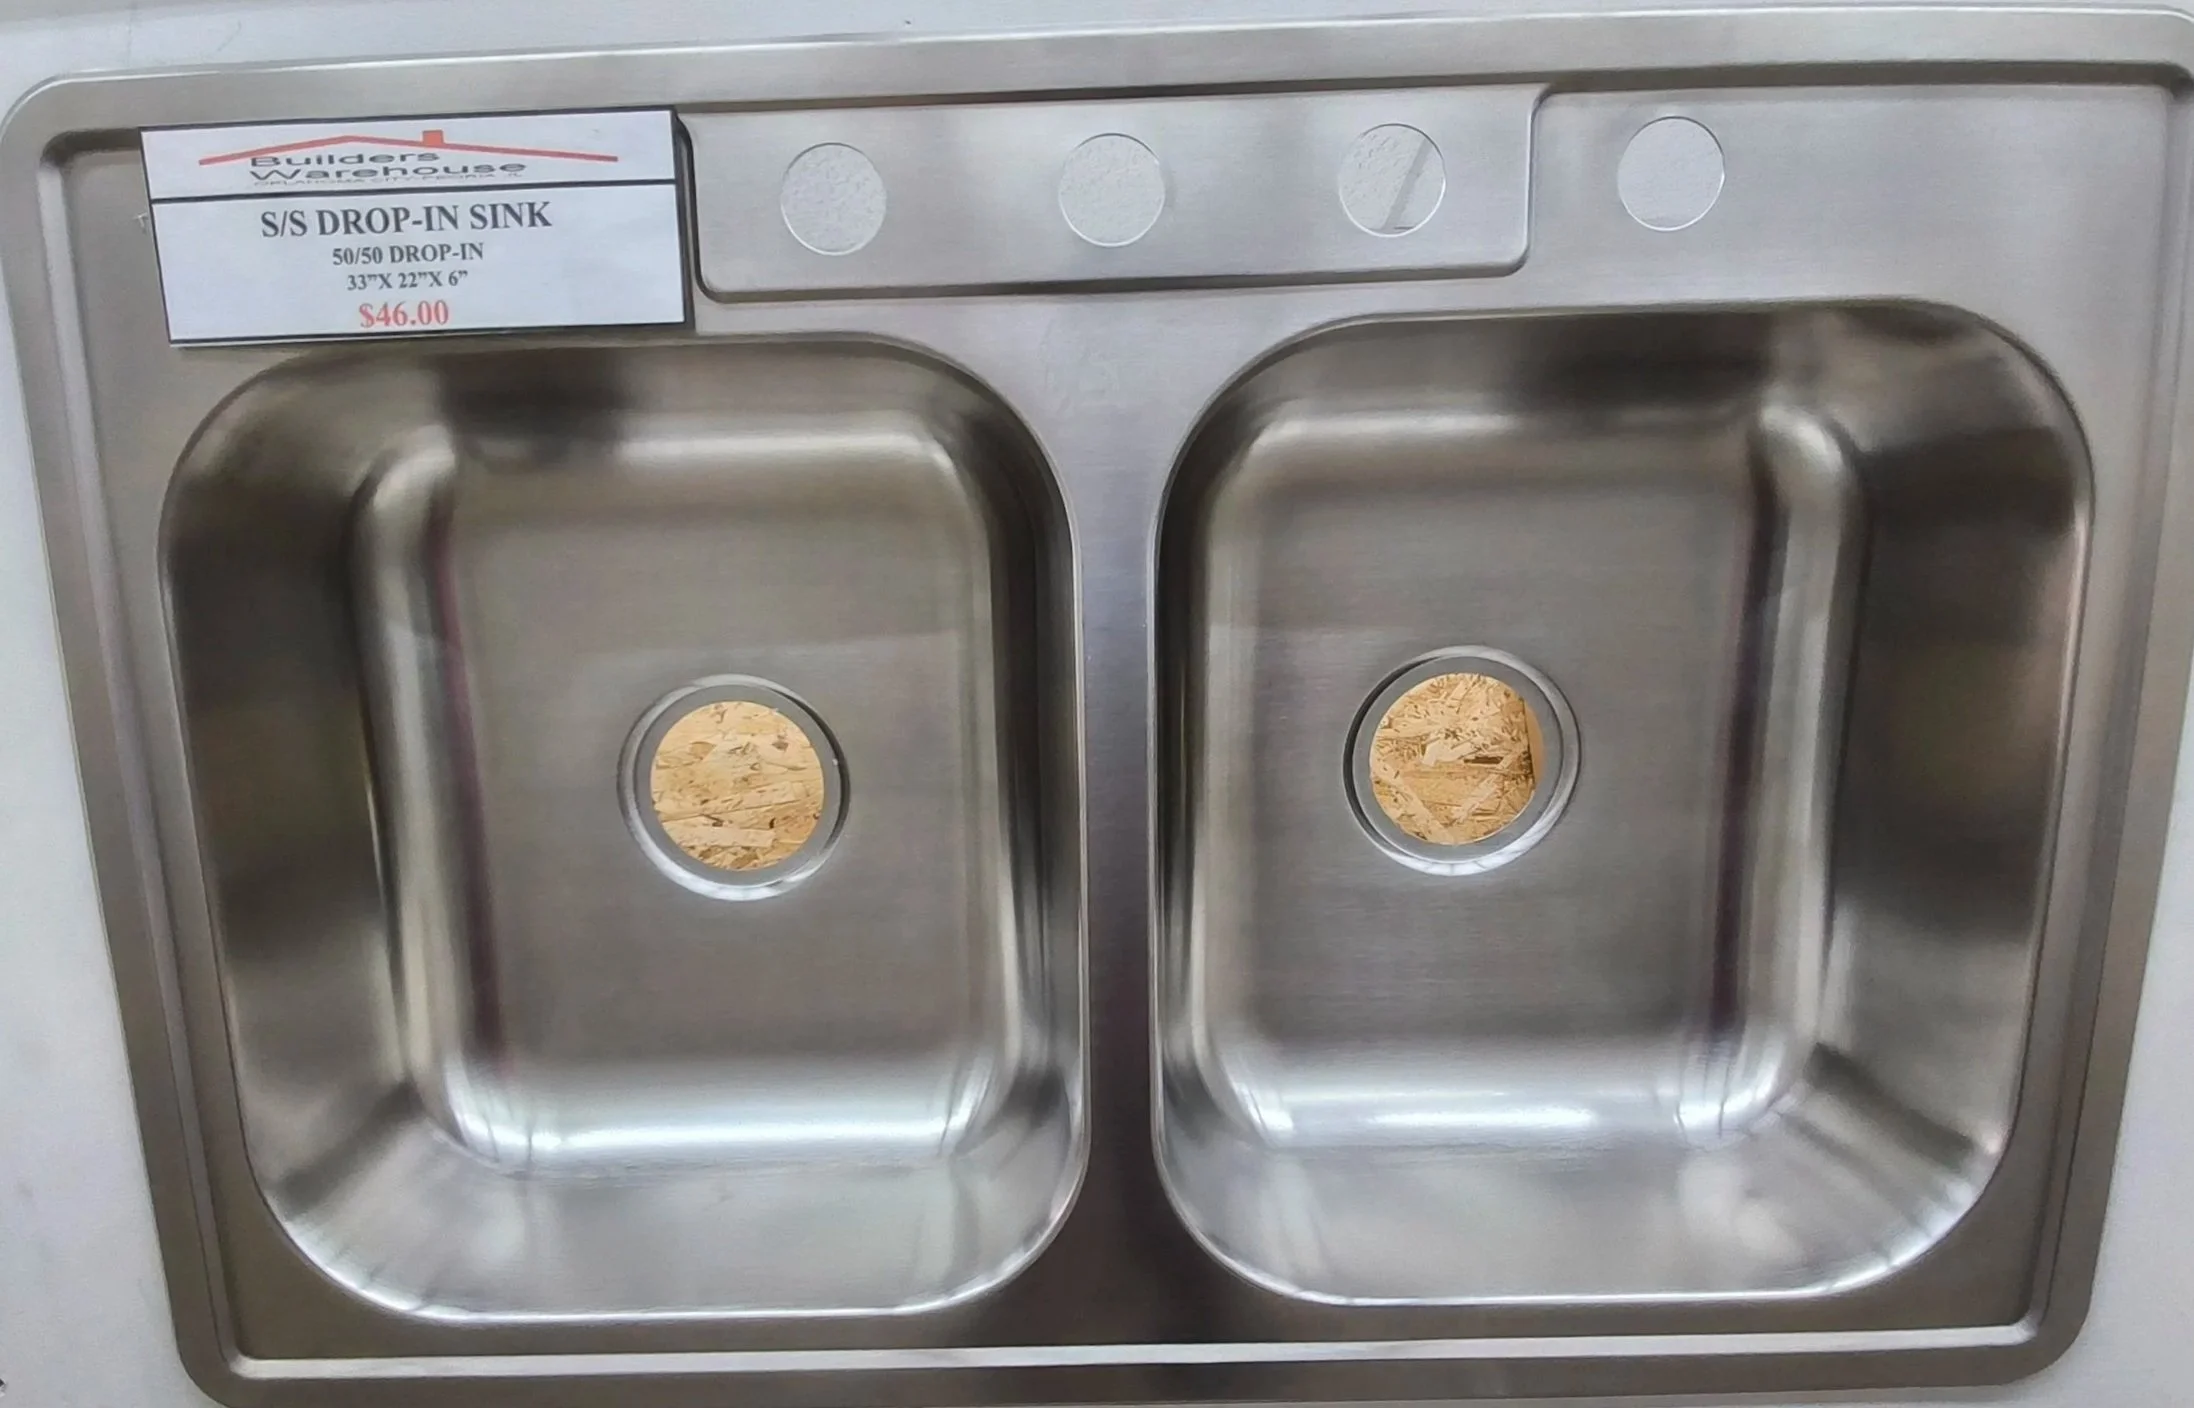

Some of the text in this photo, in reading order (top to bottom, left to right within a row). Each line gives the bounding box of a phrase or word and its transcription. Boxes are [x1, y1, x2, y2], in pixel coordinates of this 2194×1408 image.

[250, 151, 440, 167] Builders
[249, 163, 526, 180] Warehouse
[261, 201, 553, 237] S/S DROP-IN SINK
[332, 242, 484, 265] 50/50 DROP-IN
[359, 300, 450, 328] $46.00
